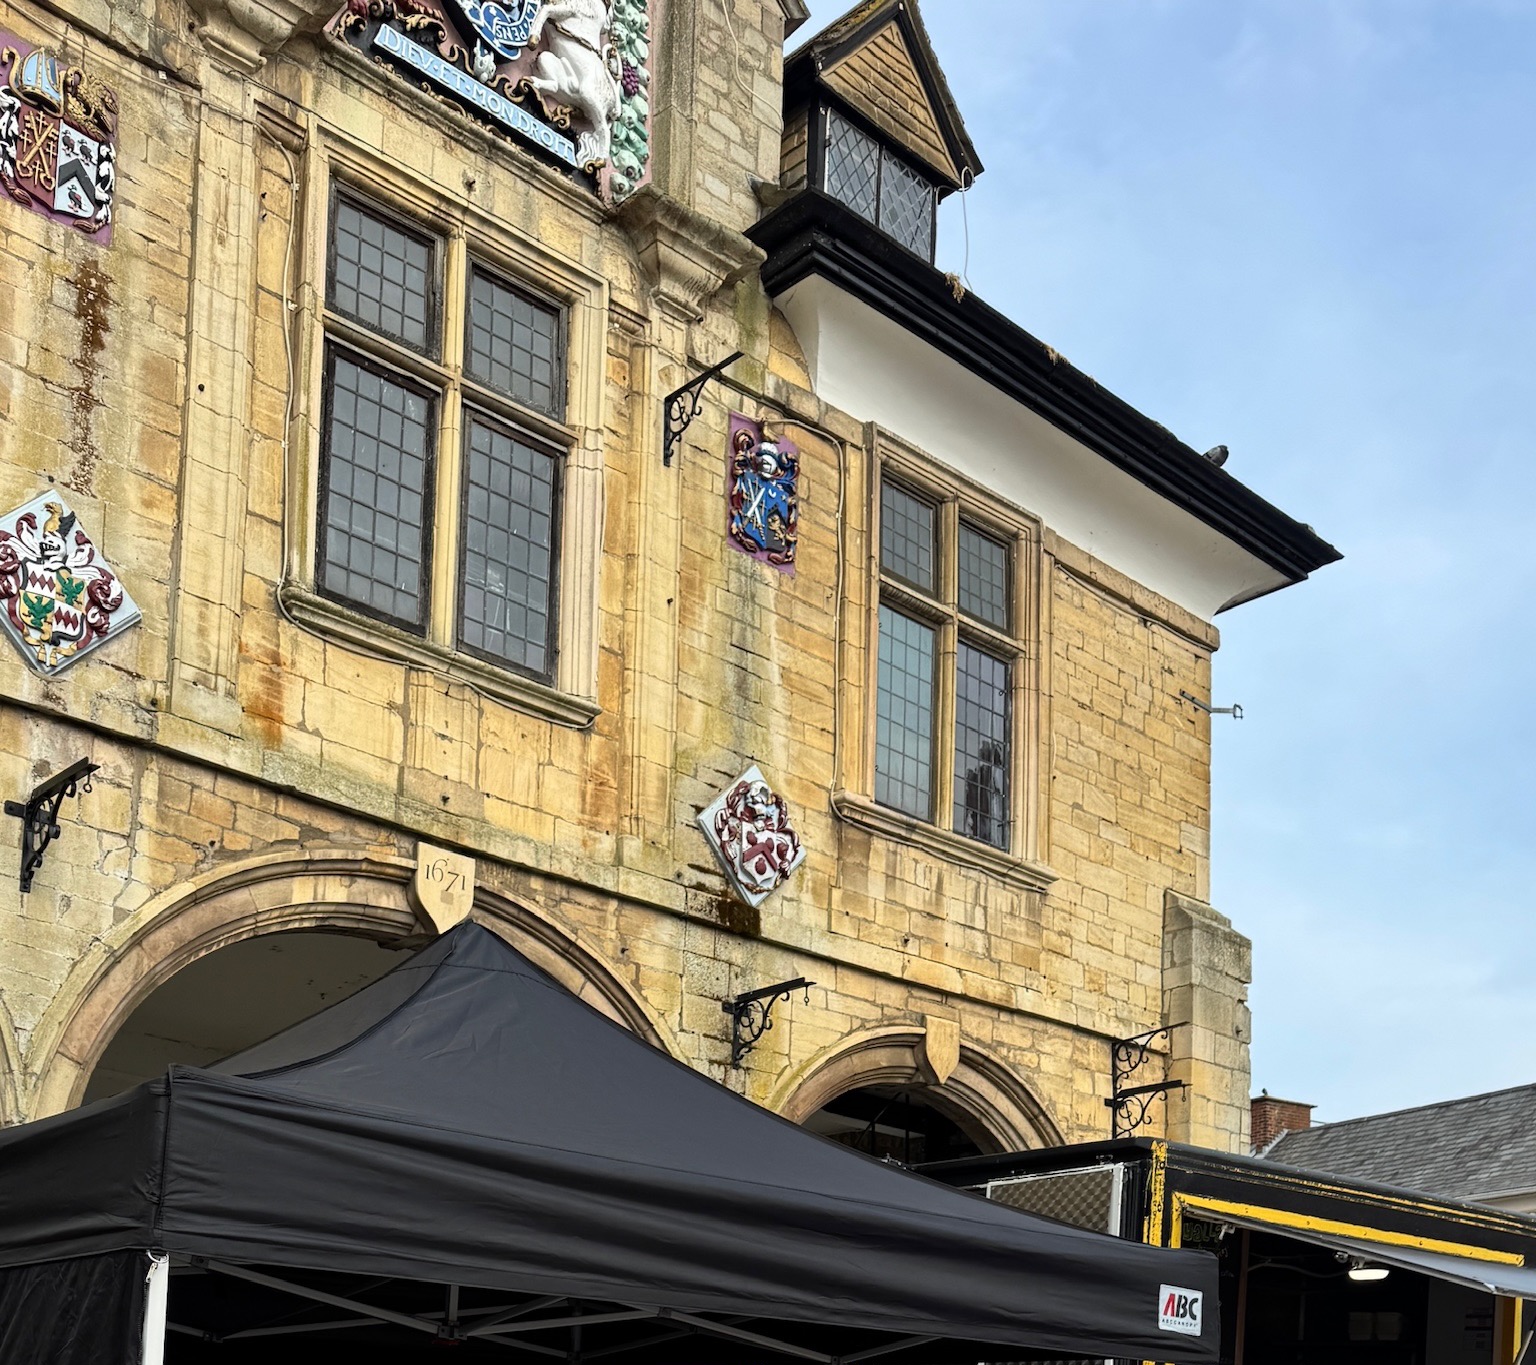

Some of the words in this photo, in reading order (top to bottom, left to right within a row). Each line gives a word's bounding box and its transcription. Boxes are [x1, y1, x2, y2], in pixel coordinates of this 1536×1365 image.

[440, 63, 467, 90] ET
[472, 86, 514, 123] MON
[518, 112, 574, 159] DROIT
[426, 858, 466, 892] 1671
[1163, 1293, 1199, 1320] ABC
